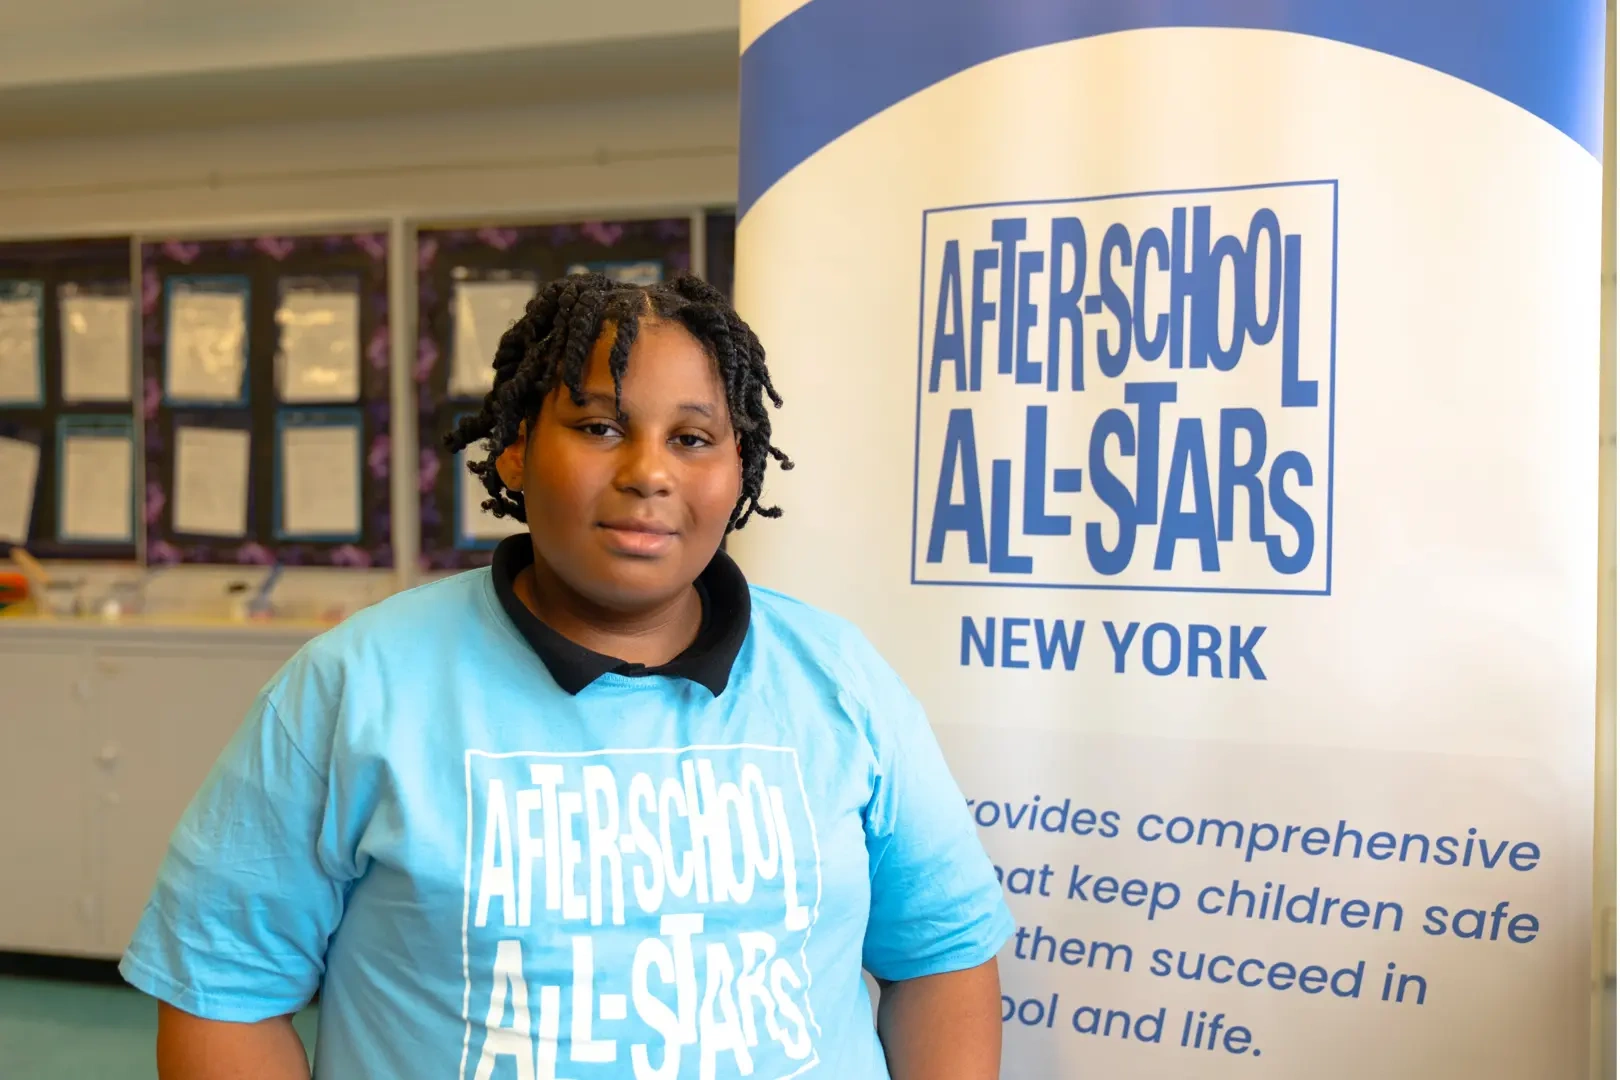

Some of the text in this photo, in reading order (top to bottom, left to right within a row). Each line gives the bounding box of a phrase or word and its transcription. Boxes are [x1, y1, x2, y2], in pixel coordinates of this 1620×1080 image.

[929, 206, 1318, 407] AFTER-SCHOOL
[926, 382, 1315, 575] ALL-STARS
[961, 616, 1267, 680] NEW YORK
[475, 759, 810, 930] AFTER-SCHOOL
[965, 795, 1540, 871] ovides comprehensive
[993, 864, 1539, 943] at keep children safe
[474, 913, 812, 1080] ALL-STARS
[1014, 926, 1427, 1004] them succeed in
[1072, 1002, 1166, 1043] and
[1181, 1011, 1263, 1057] life.
